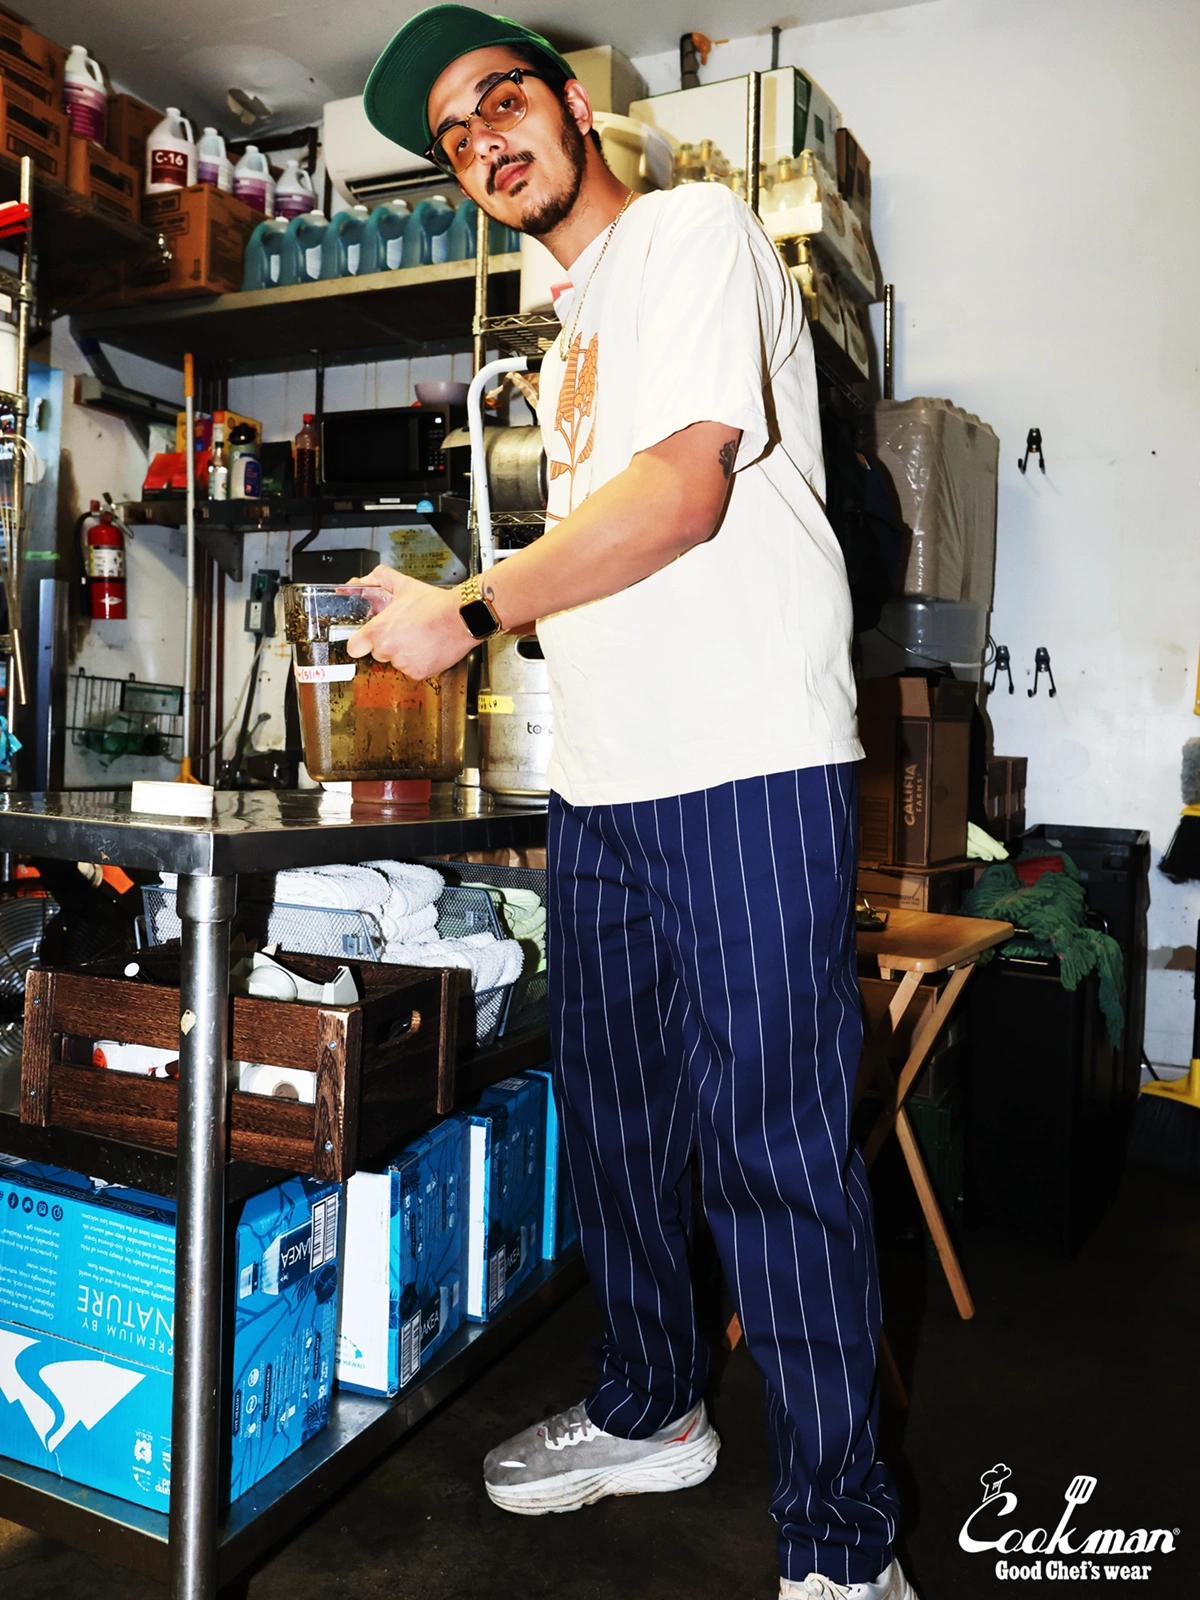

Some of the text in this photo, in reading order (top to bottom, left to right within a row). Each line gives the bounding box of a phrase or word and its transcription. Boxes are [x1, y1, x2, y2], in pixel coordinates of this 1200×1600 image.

[155, 151, 184, 166] C-16
[903, 764, 918, 826] CALIFIA
[34, 1225, 52, 1235] precious
[90, 1226, 104, 1234] source
[109, 1220, 125, 1230] Mauna
[84, 1235, 97, 1243] forest
[115, 1233, 126, 1241] deep
[139, 1230, 150, 1238] base
[35, 1236, 59, 1248] responsibly
[127, 1236, 152, 1248] sustainable
[30, 1247, 52, 1257] protectors
[80, 1243, 90, 1252] Hilo
[135, 1248, 141, 1256] by
[109, 1252, 123, 1261] sleepy
[142, 1252, 168, 1263] surrounded
[133, 1259, 150, 1269] outside
[40, 1266, 57, 1275] volcanic
[99, 1265, 115, 1275] ultimate
[31, 1273, 56, 1286] refreshingly
[127, 1273, 140, 1282] purity
[140, 1278, 153, 1287] offers
[24, 1283, 33, 1291] lava
[34, 1286, 50, 1295] porous
[121, 1283, 131, 1292] from
[15, 1291, 27, 1300] slowly
[151, 1291, 174, 1303] ompletely
[29, 1306, 54, 1320] Originating
[77, 1285, 175, 1341] NATURE
[82, 1317, 173, 1356] PREMIUM BY
